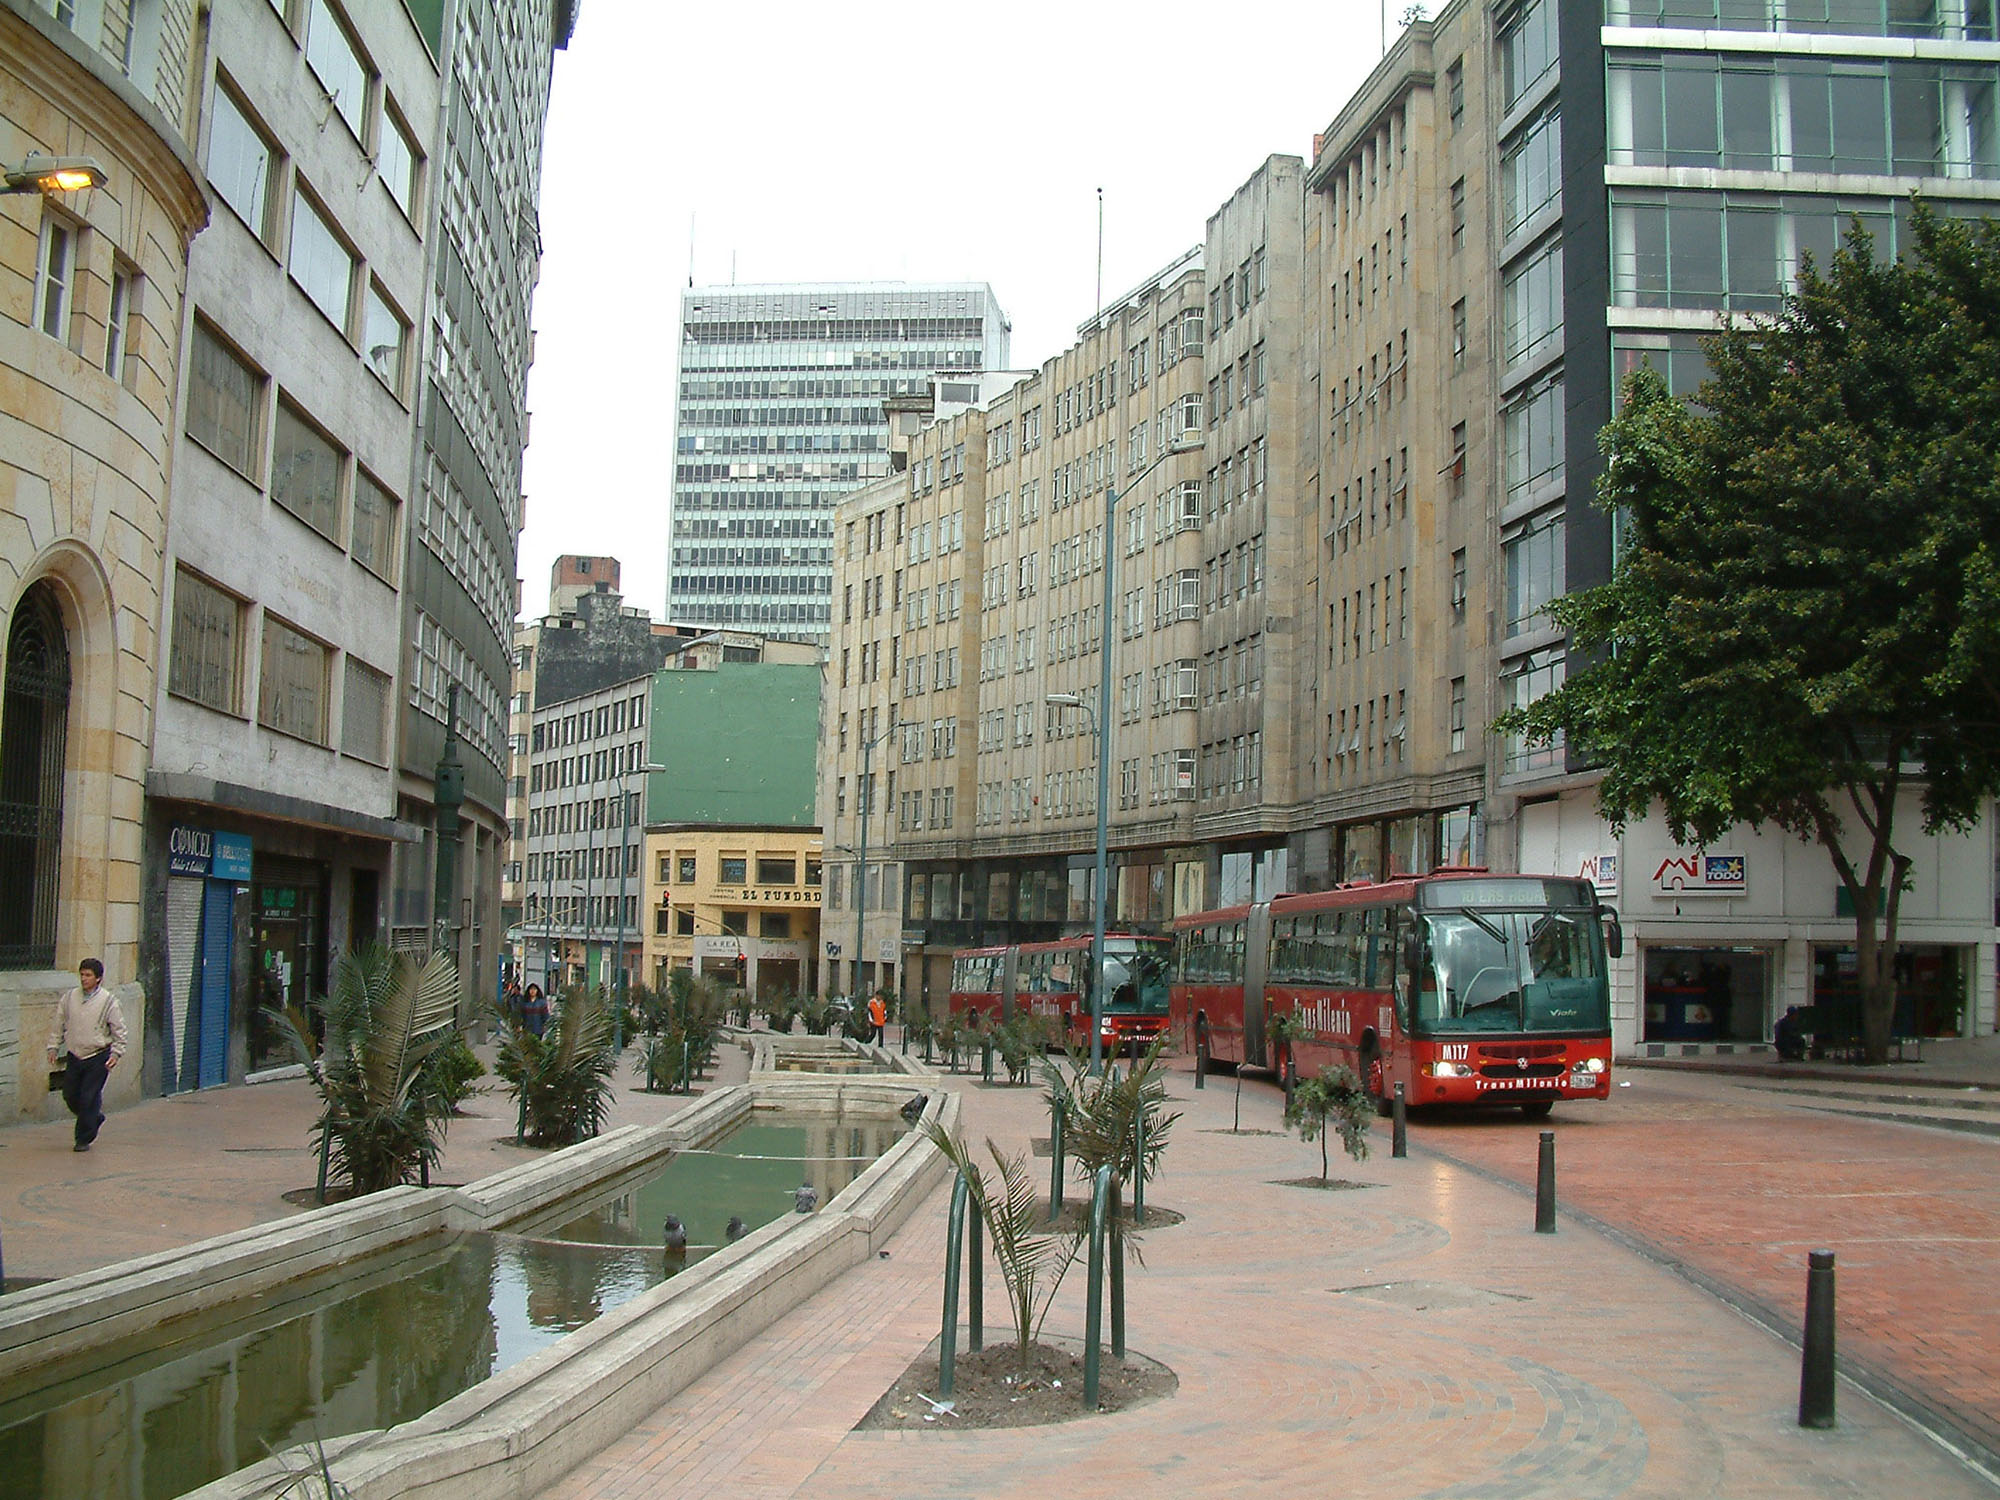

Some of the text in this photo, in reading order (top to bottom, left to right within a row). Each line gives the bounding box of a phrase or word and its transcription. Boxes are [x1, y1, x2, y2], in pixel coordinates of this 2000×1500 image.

[170, 826, 212, 858] COMCEL
[1652, 854, 1699, 881] Mi
[1707, 871, 1742, 880] TODO
[742, 890, 757, 900] EL
[1442, 1044, 1469, 1061] M117
[1475, 1078, 1568, 1090] TransMilenio
